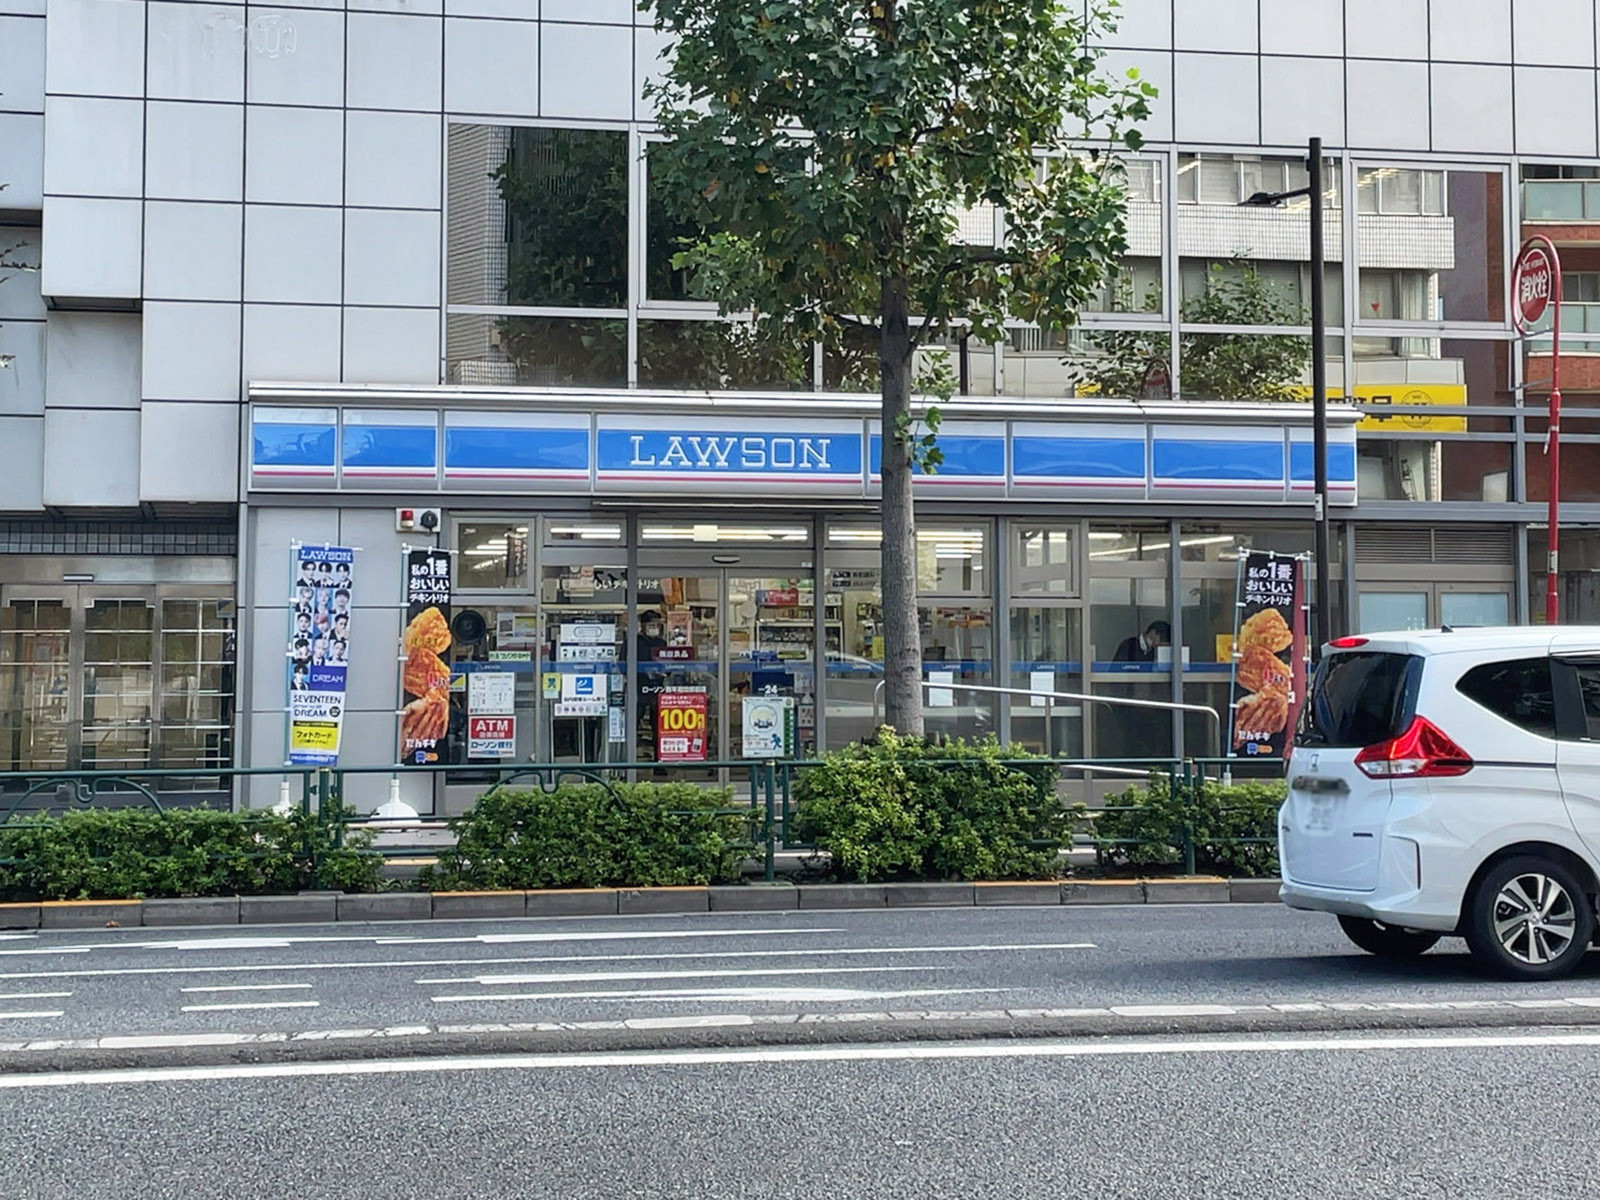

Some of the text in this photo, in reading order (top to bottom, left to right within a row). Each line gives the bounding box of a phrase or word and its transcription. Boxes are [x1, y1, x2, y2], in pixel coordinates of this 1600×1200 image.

[1521, 269, 1548, 304] 消火栓
[630, 435, 831, 469] LAWSON
[301, 549, 351, 562] LAWSON
[411, 557, 448, 576] 私の1番
[1248, 562, 1292, 580] 私の1番
[410, 578, 449, 590] おいしい
[1246, 580, 1293, 593] おいしい
[409, 594, 449, 604] チキントリオ
[1245, 594, 1292, 606] チキントリオ
[312, 674, 344, 683] DREAM
[293, 694, 341, 704] SEVENTEEN
[294, 709, 327, 718] DREAM
[476, 720, 509, 732] ATM
[296, 731, 332, 741] フォトカード
[471, 741, 513, 749] ローソン銀行
